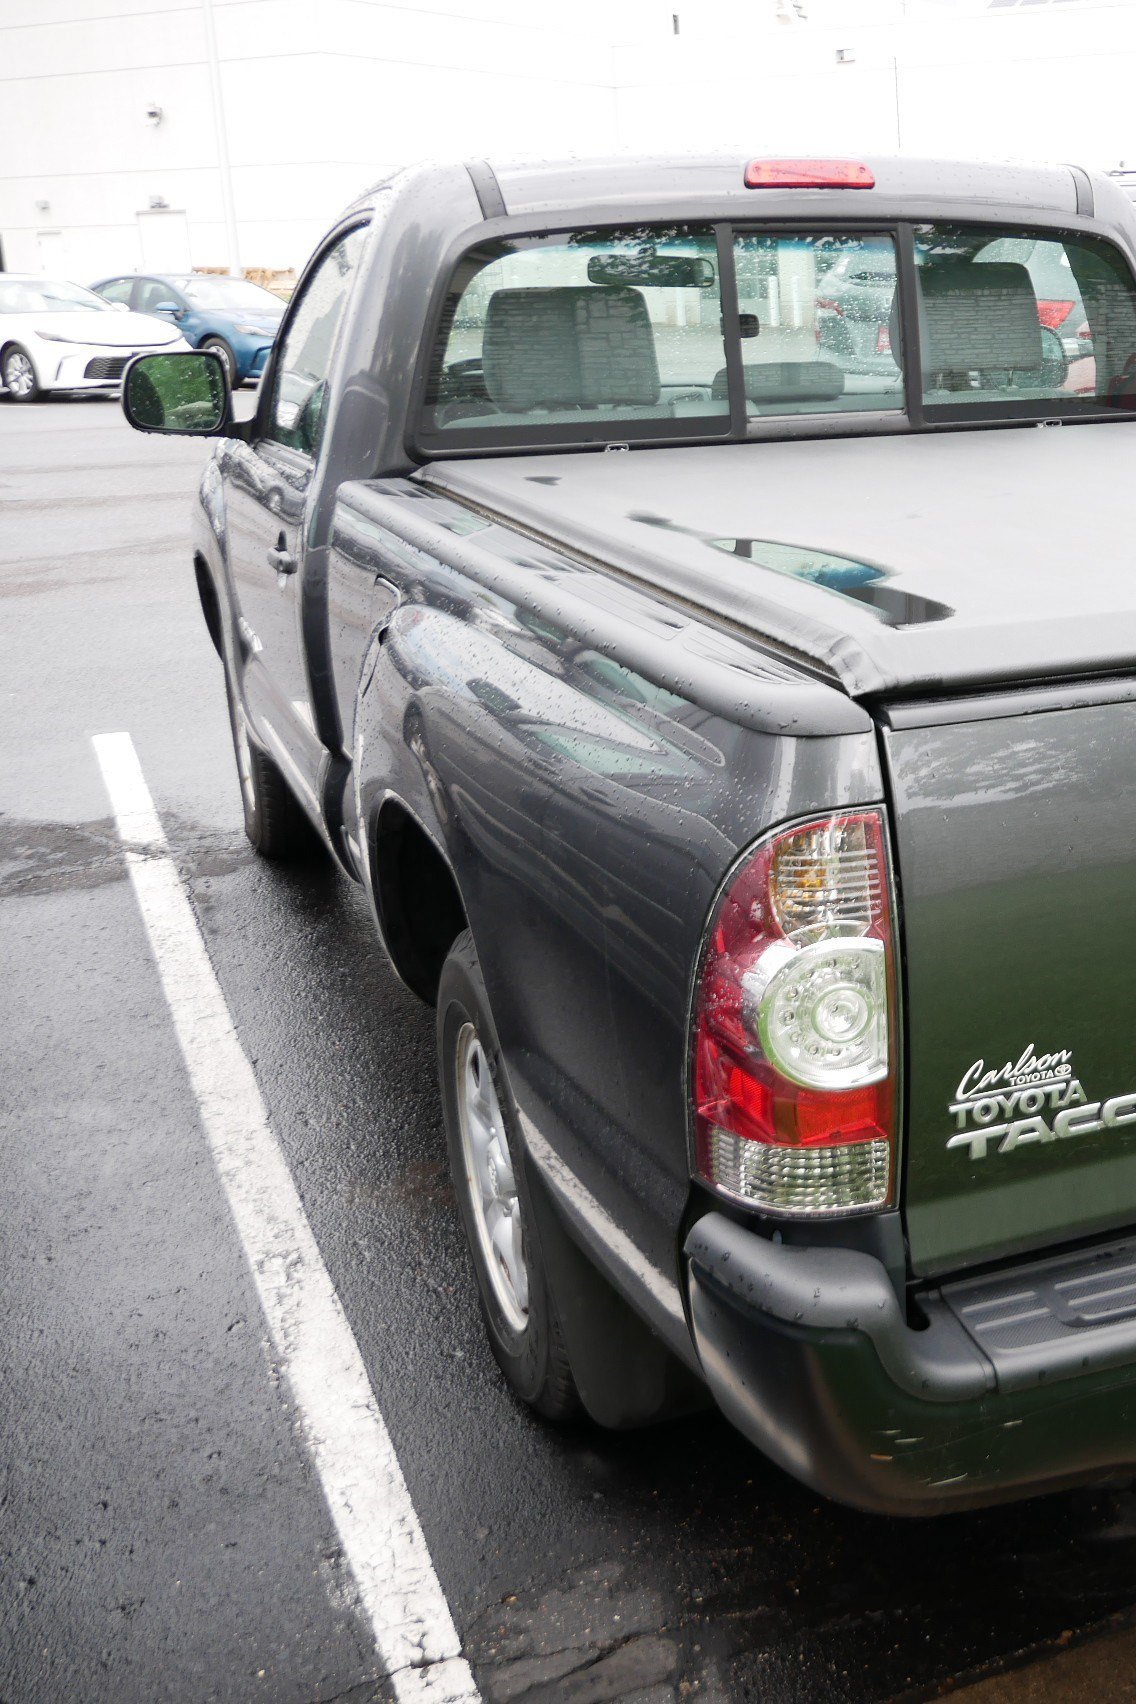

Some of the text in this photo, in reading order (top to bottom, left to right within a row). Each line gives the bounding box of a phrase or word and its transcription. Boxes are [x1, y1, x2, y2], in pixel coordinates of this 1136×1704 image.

[956, 1043, 1073, 1101] Carlson
[1009, 1070, 1055, 1087] TOYOTA
[948, 1079, 1088, 1129] TOYOTA
